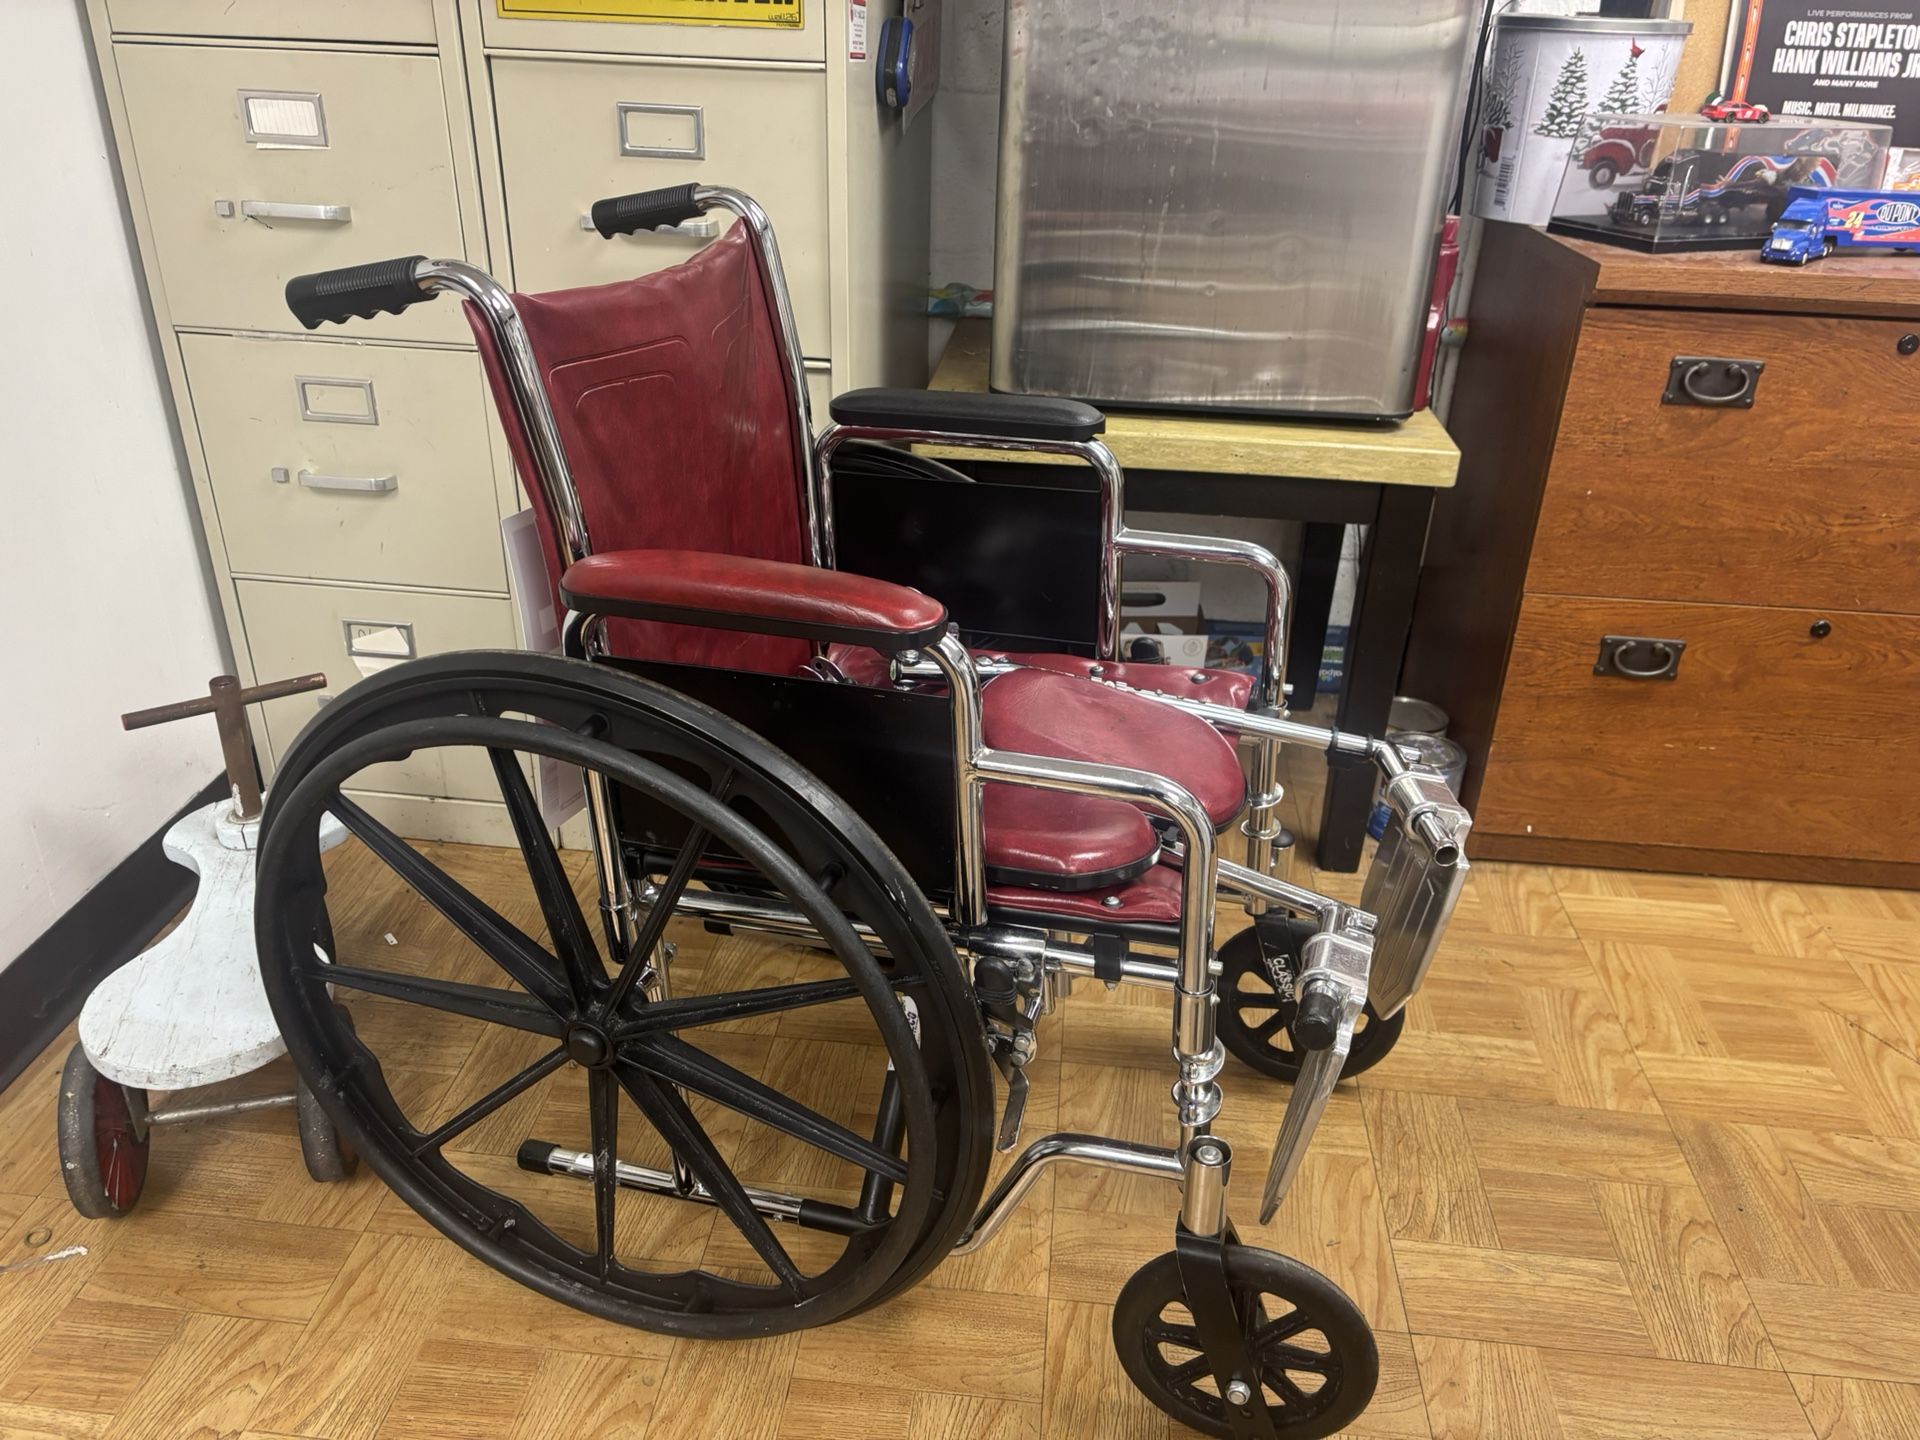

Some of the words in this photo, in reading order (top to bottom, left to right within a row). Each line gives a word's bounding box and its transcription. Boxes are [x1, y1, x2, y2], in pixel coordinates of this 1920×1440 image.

[1807, 9, 1824, 17] LIVE
[1825, 10, 1889, 18] PERFORMANCES
[1784, 20, 1834, 47] CHRIS
[1772, 48, 1820, 75] HANK
[1820, 50, 1902, 78] WILLIAMS
[1813, 79, 1831, 87] AND
[1831, 80, 1855, 88] MANY
[1782, 100, 1813, 115] MUSIC.
[1814, 102, 1841, 117] MOTO.
[1842, 103, 1896, 119] MILWAUKEE.
[1844, 211, 1865, 229] 24
[1273, 958, 1295, 998] CLASSIC
